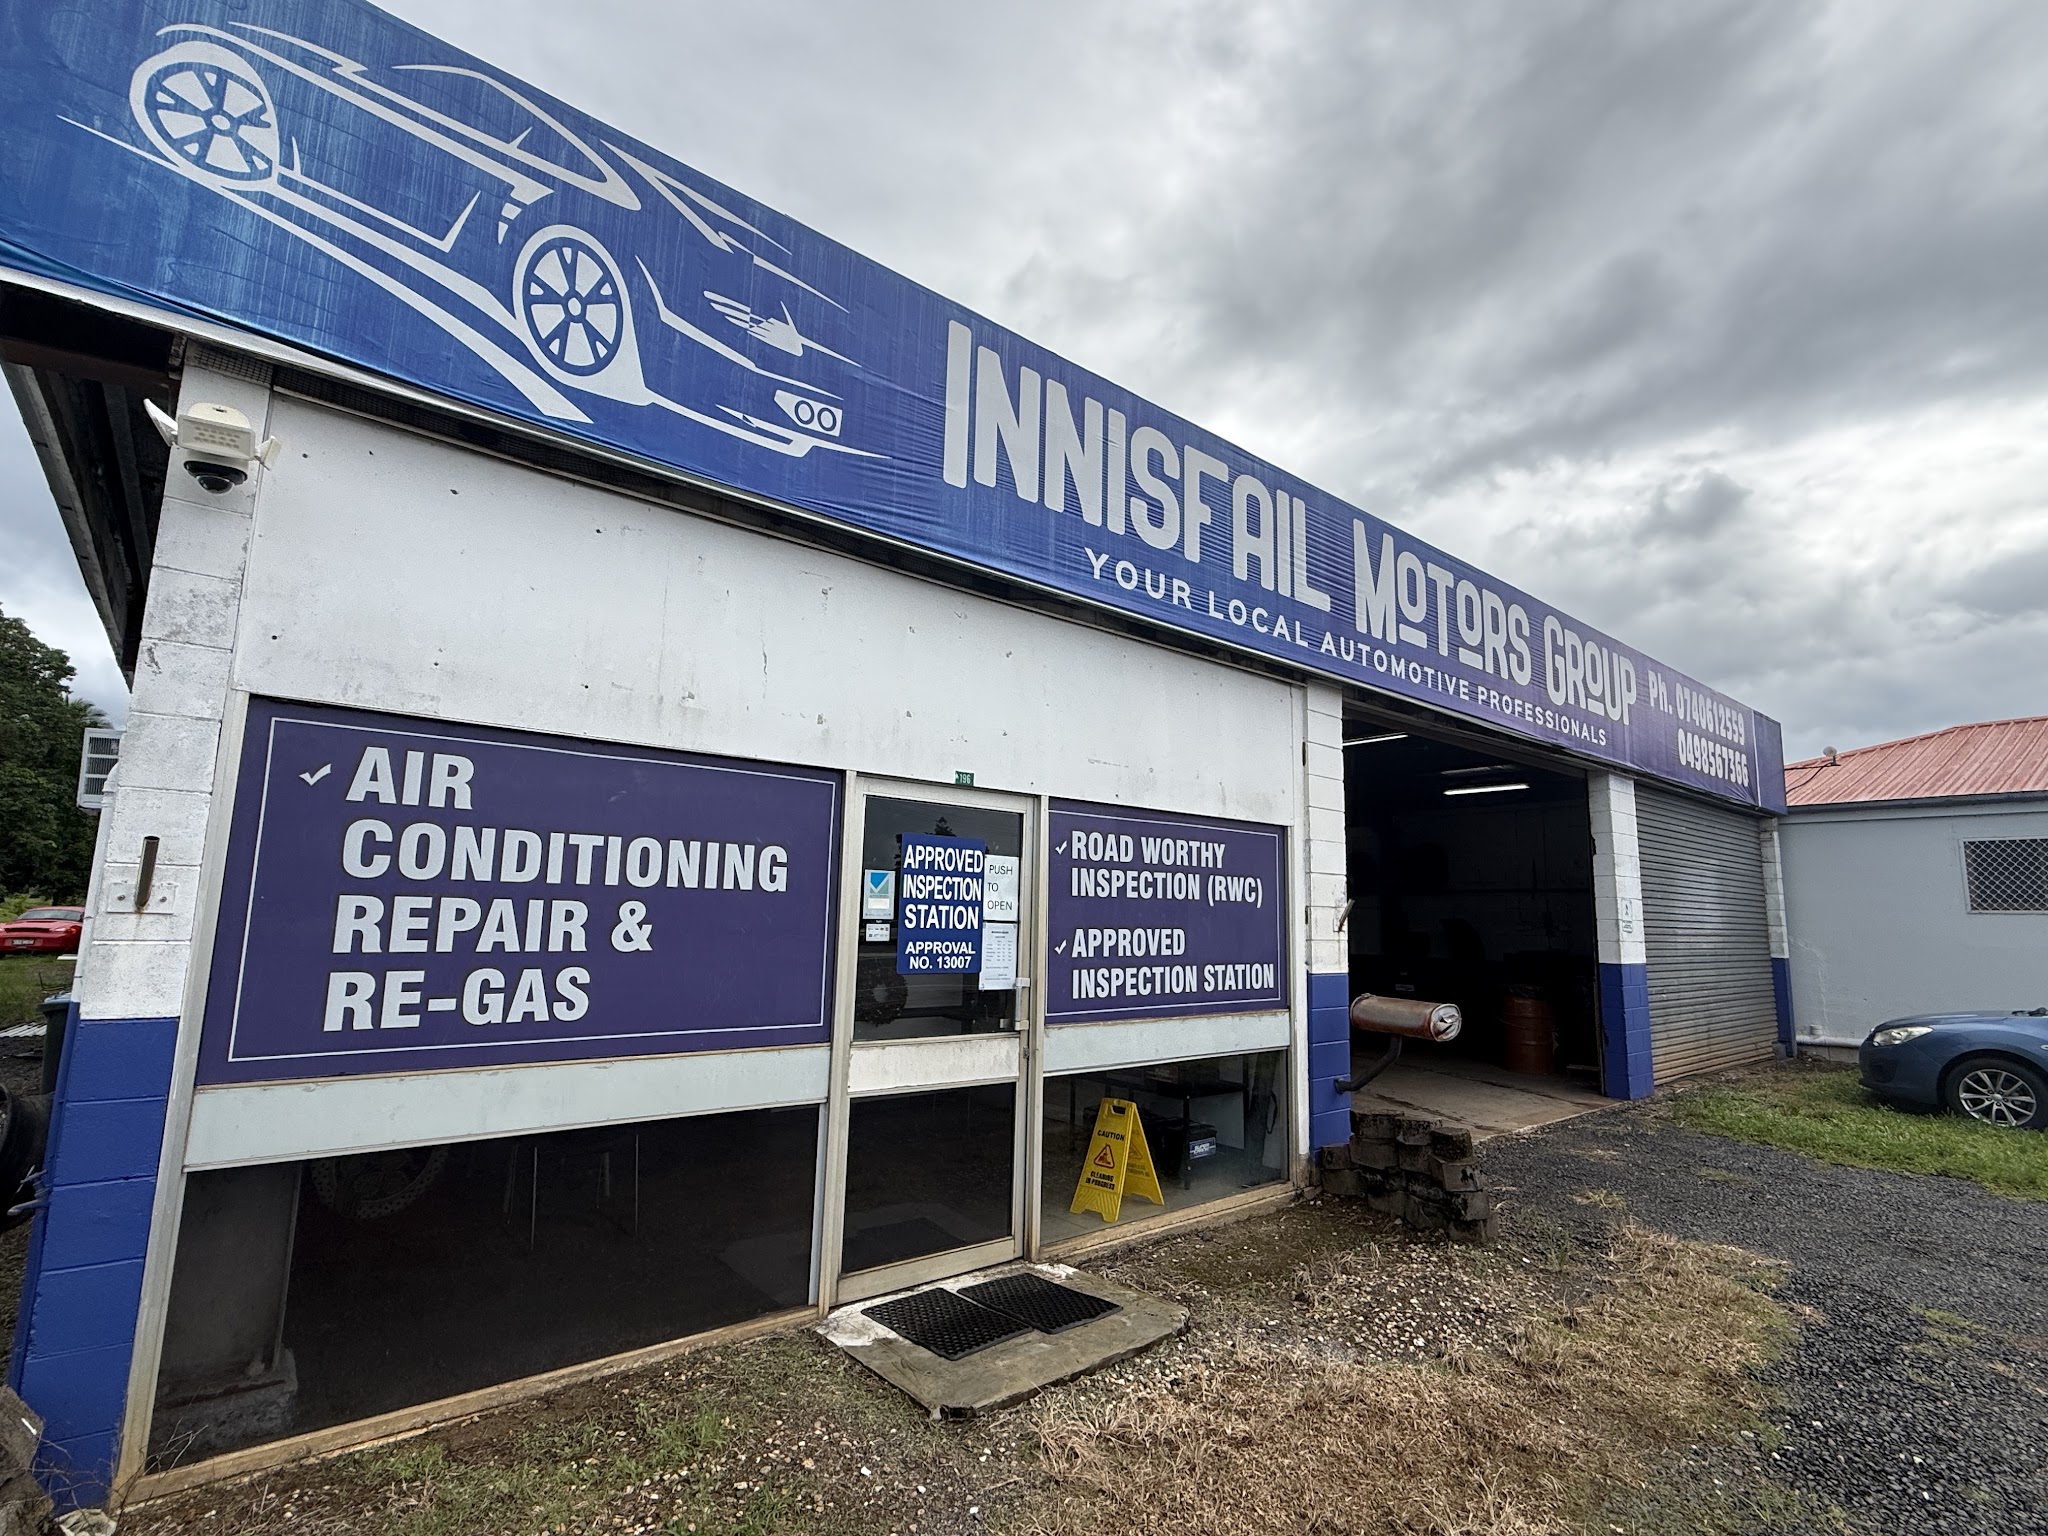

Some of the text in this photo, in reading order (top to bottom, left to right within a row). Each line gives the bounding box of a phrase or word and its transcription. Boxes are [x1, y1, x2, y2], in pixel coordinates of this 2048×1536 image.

[943, 320, 1637, 725] INNISFAIL MOTORS GROUP
[1084, 547, 1607, 746] YOUR LOCAL AUTOMOTIVE PROFESSIONALS
[1648, 669, 1744, 746] Ph. 0740612559
[1678, 728, 1749, 787] 0498567366
[345, 746, 475, 809] AIR
[960, 773, 971, 784] 196
[343, 819, 788, 892] CONDITIONING
[903, 844, 984, 873] APPROVED
[1072, 830, 1225, 868] ROAD WORTHY
[988, 864, 1013, 875] PUSH
[902, 873, 982, 901] INSPECTION
[988, 882, 999, 892] TO
[1071, 867, 1263, 908] INSPECTION (RWC)
[904, 904, 979, 929] STATION
[987, 900, 1013, 911] OPEN
[332, 895, 653, 953] REPAIR &
[905, 941, 976, 955] APPROVAL
[1071, 928, 1186, 958] APPROVED
[909, 955, 972, 969] NO. 13007
[1072, 963, 1274, 999] INSPECTION STATION
[323, 966, 591, 1032] RE-GAS
[1097, 1130, 1125, 1141] CAUTION
